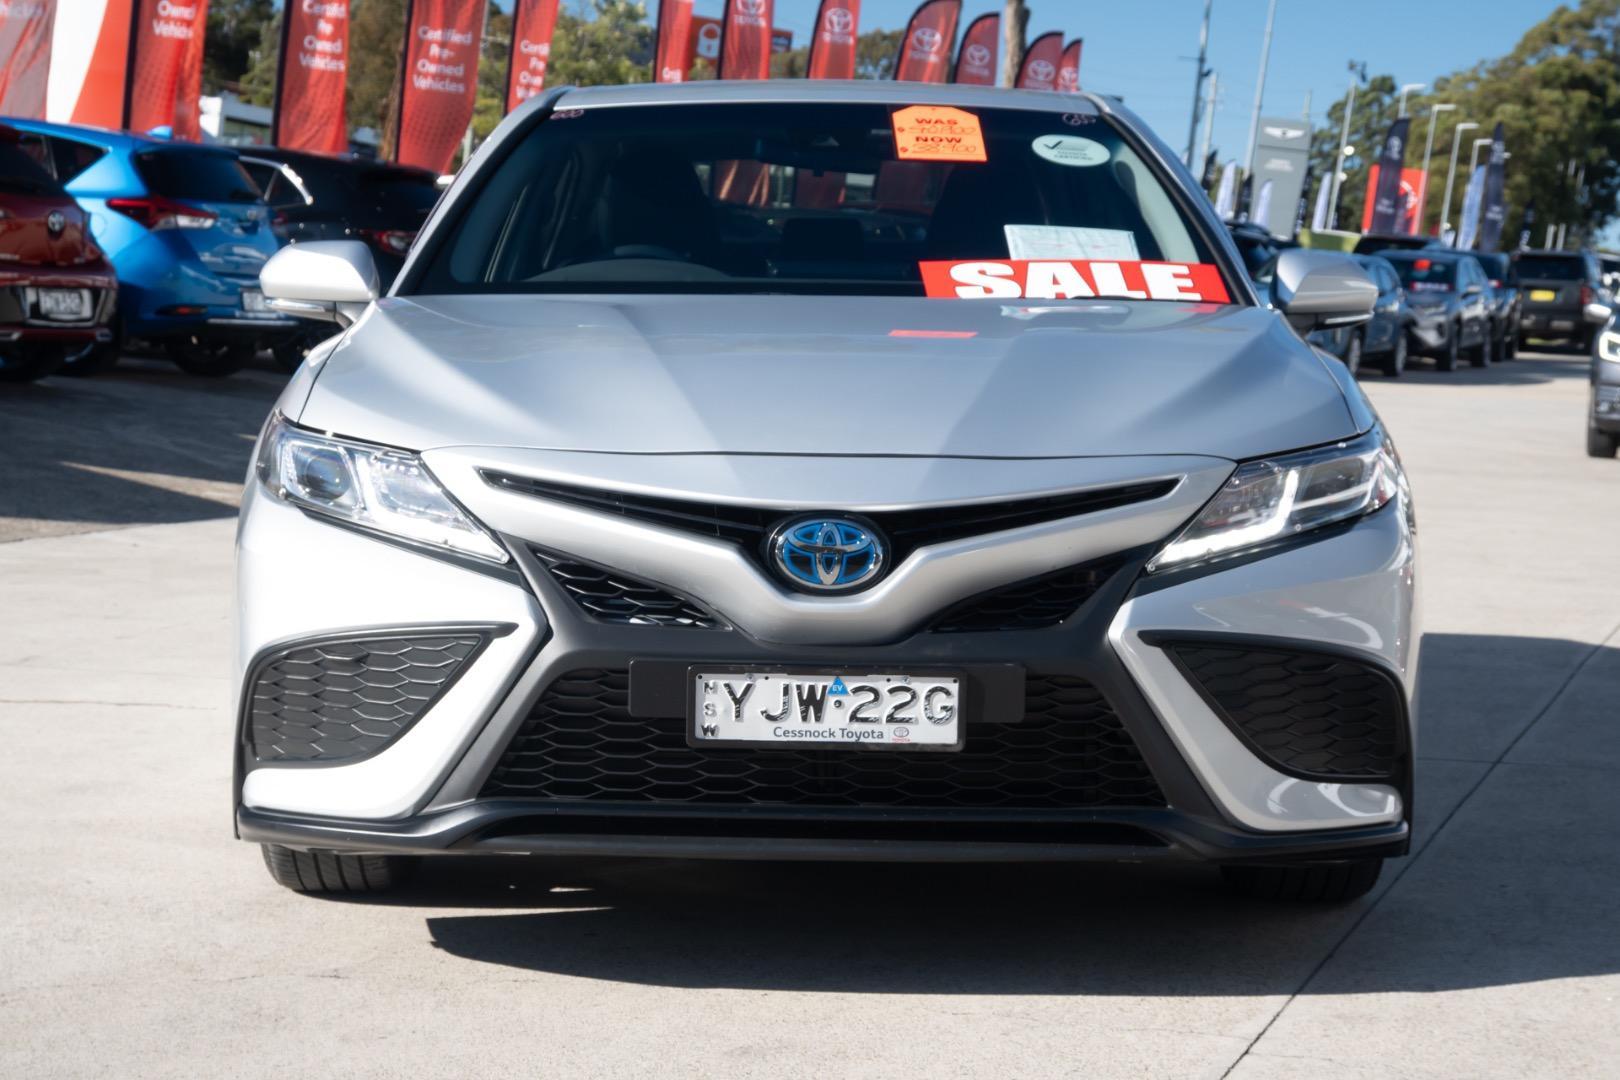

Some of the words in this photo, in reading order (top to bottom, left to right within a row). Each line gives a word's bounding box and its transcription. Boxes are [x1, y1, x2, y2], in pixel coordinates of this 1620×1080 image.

[418, 25, 473, 46] Certified
[417, 58, 465, 77] Owned
[412, 74, 465, 95] Vehicles
[915, 118, 959, 126] WAS
[915, 135, 962, 144] NOW
[949, 261, 1203, 301] SALE
[832, 684, 847, 692] EV
[773, 726, 836, 740] Cessnock
[838, 727, 884, 742] Toyota
